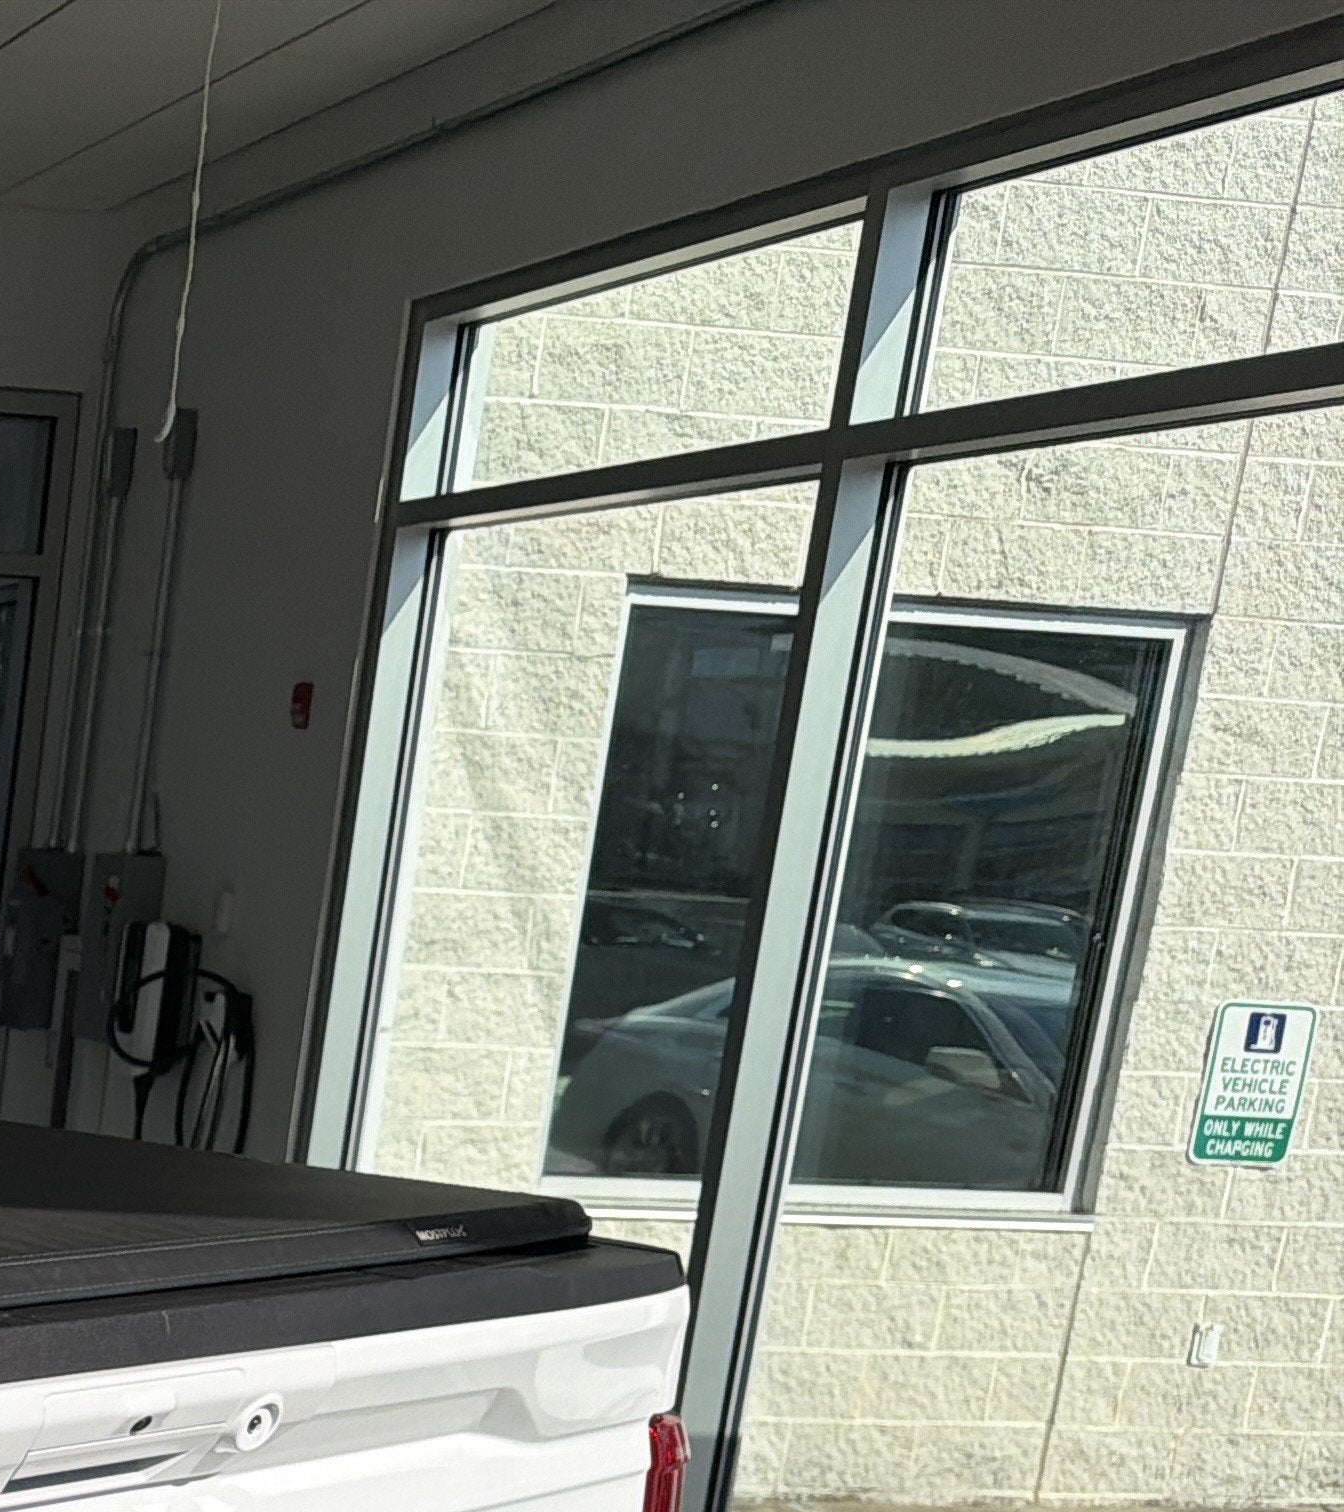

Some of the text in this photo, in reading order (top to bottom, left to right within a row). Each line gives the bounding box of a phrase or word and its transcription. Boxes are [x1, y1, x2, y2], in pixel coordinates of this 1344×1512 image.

[1220, 1057, 1297, 1076] ELECTRIC
[1221, 1076, 1290, 1096] VEHICLE
[1214, 1095, 1286, 1113] PARKING
[1203, 1119, 1287, 1139] ONLY WHILE
[1206, 1139, 1275, 1158] CHARGING
